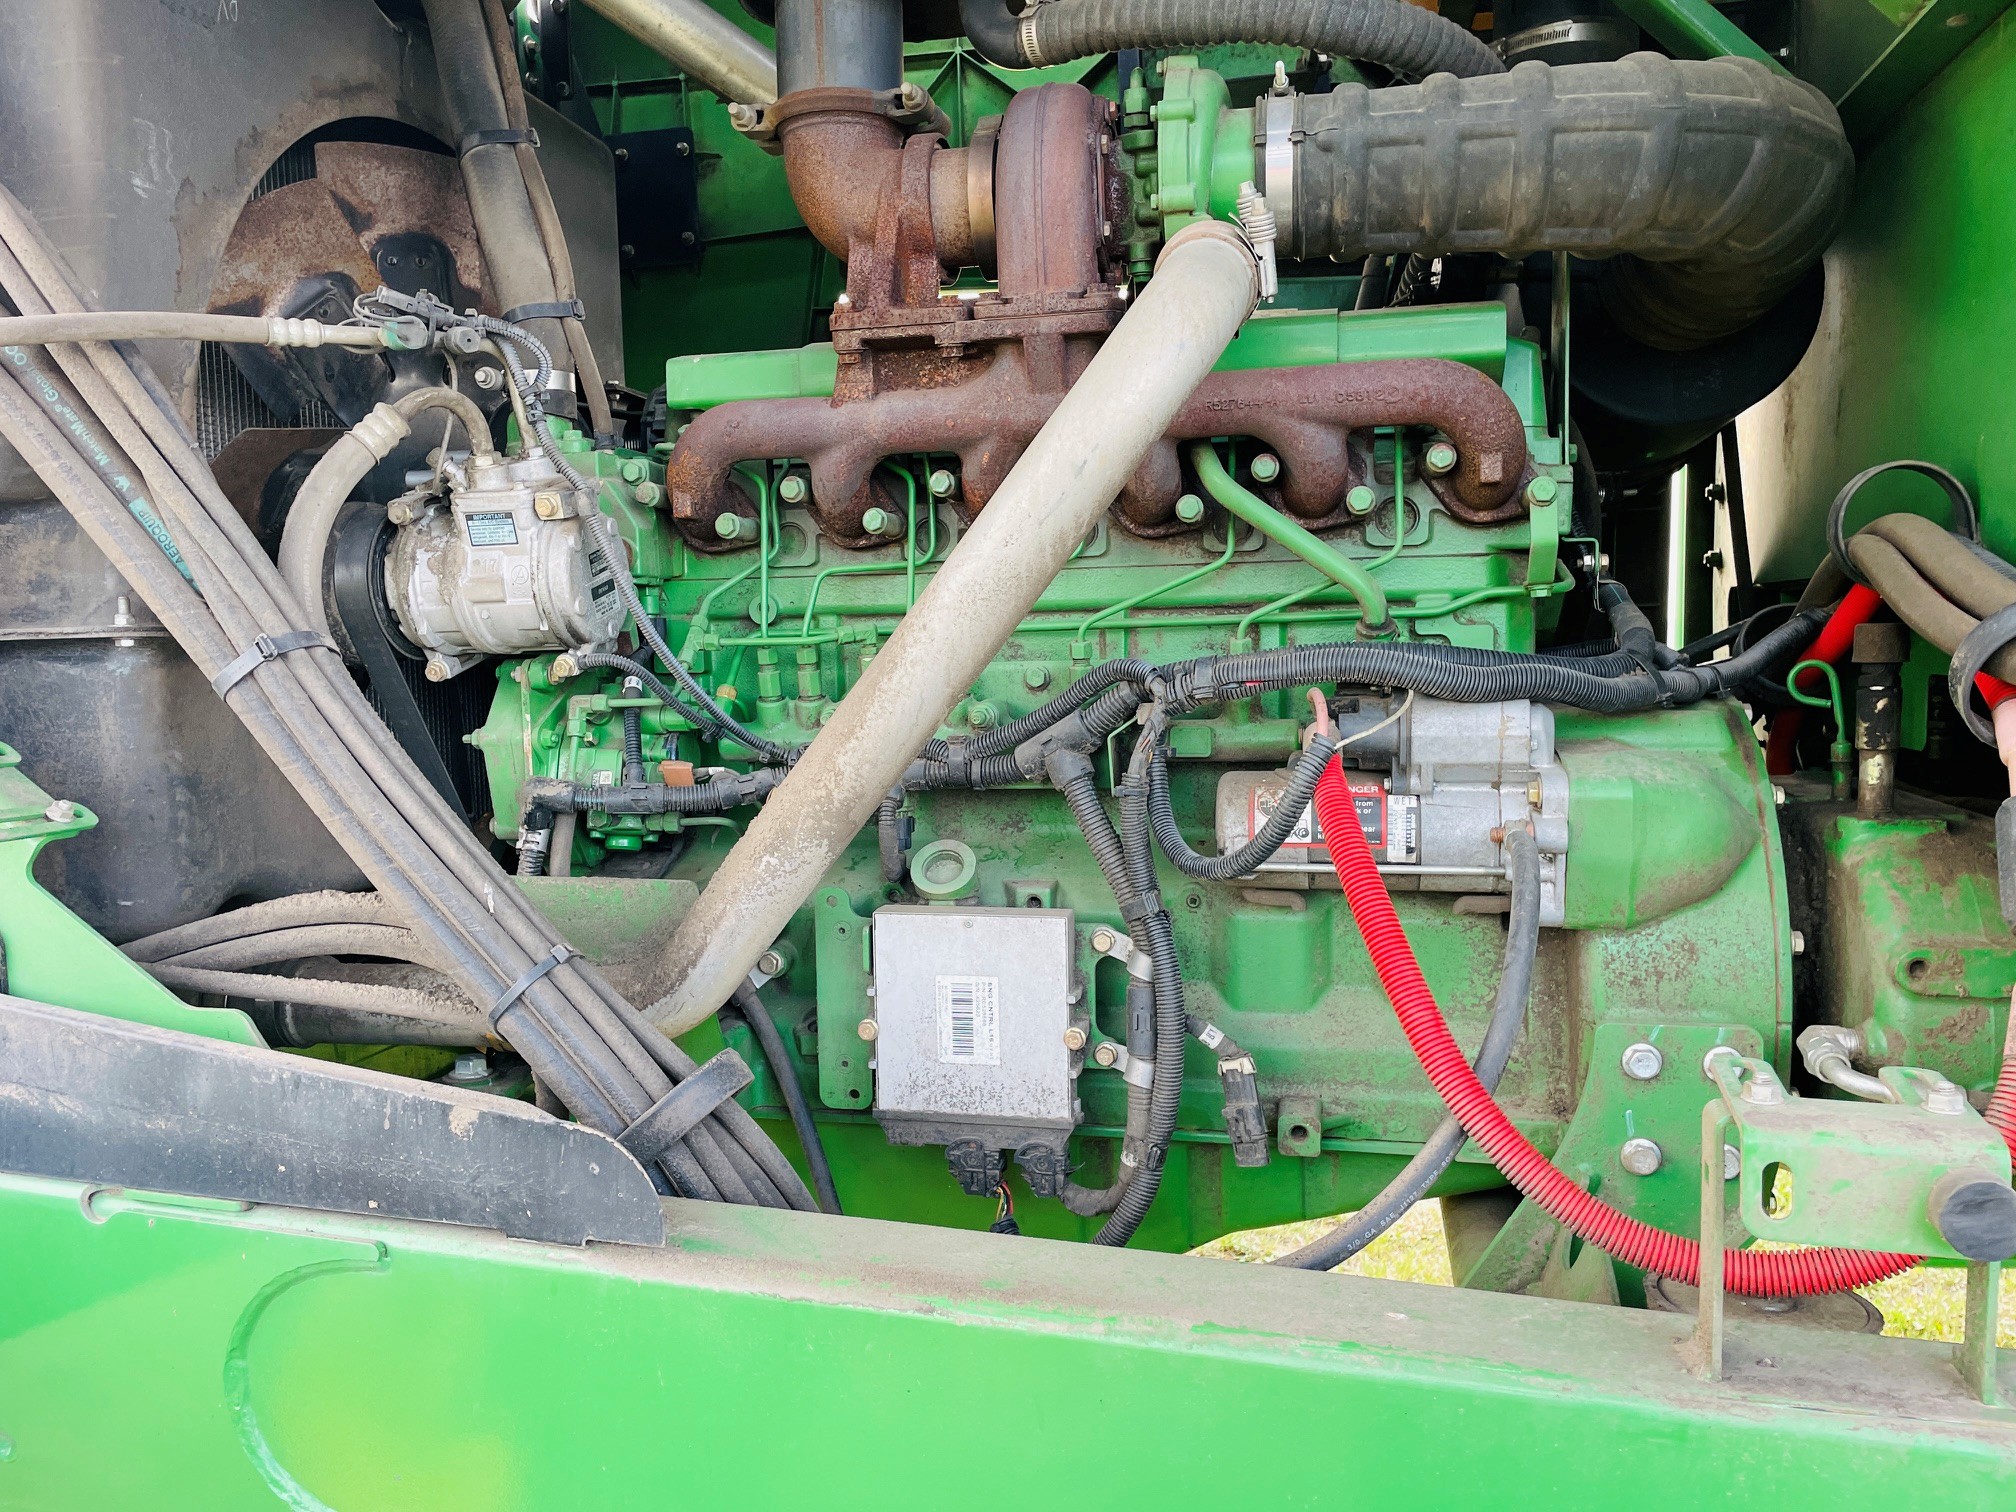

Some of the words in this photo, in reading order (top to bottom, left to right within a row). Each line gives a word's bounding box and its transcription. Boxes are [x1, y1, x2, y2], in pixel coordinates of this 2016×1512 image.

[27, 366, 59, 402] Global
[472, 513, 506, 521] IMPORTANT
[138, 509, 185, 565] AEROQUIP
[1348, 785, 1379, 793] NGER
[1393, 796, 1413, 805] WET
[1364, 1227, 1377, 1239] GA
[1380, 1212, 1396, 1227] SAE
[1399, 1191, 1418, 1211] J1127
[1421, 1169, 1439, 1189] TYPE
